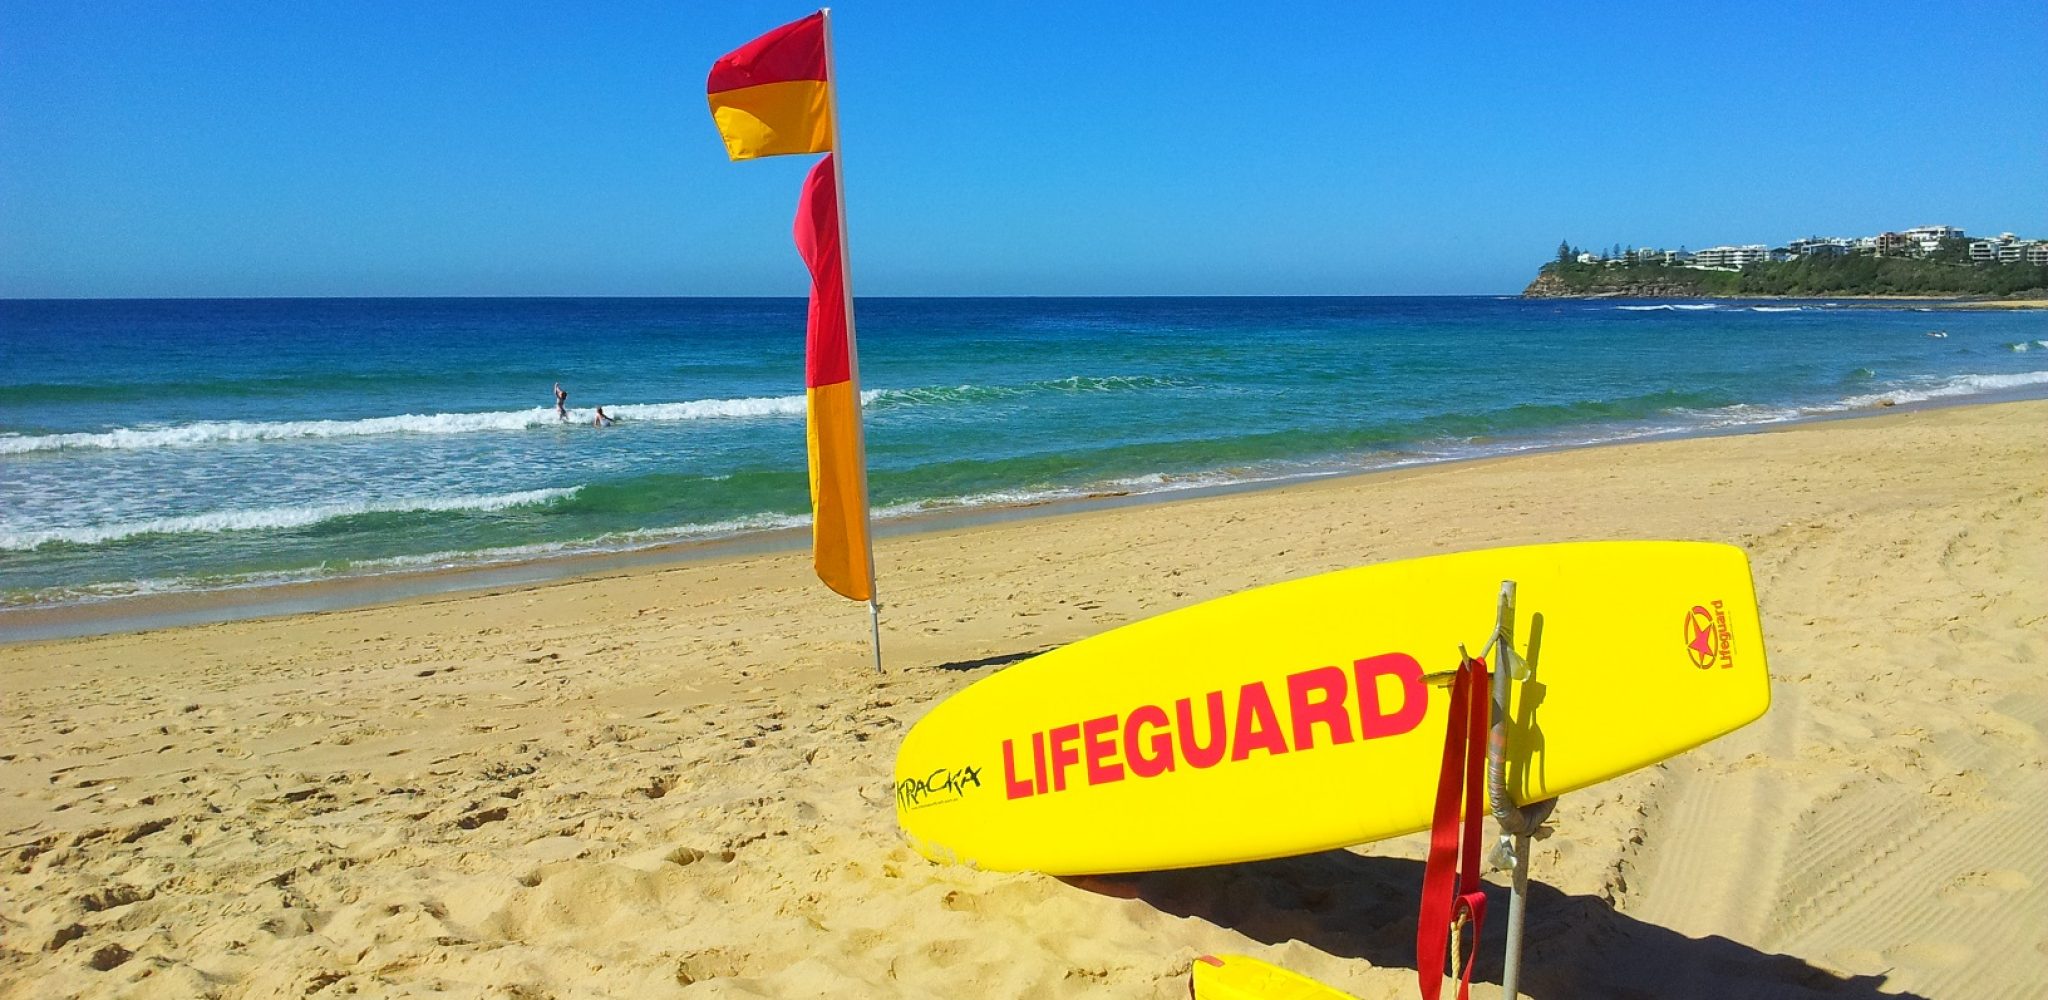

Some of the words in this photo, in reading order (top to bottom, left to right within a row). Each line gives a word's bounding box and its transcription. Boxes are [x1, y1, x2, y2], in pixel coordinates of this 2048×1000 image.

[1710, 599, 1733, 669] Lifeguard
[1002, 652, 1428, 800] LIFEGUARD
[896, 766, 982, 813] KRACKA
